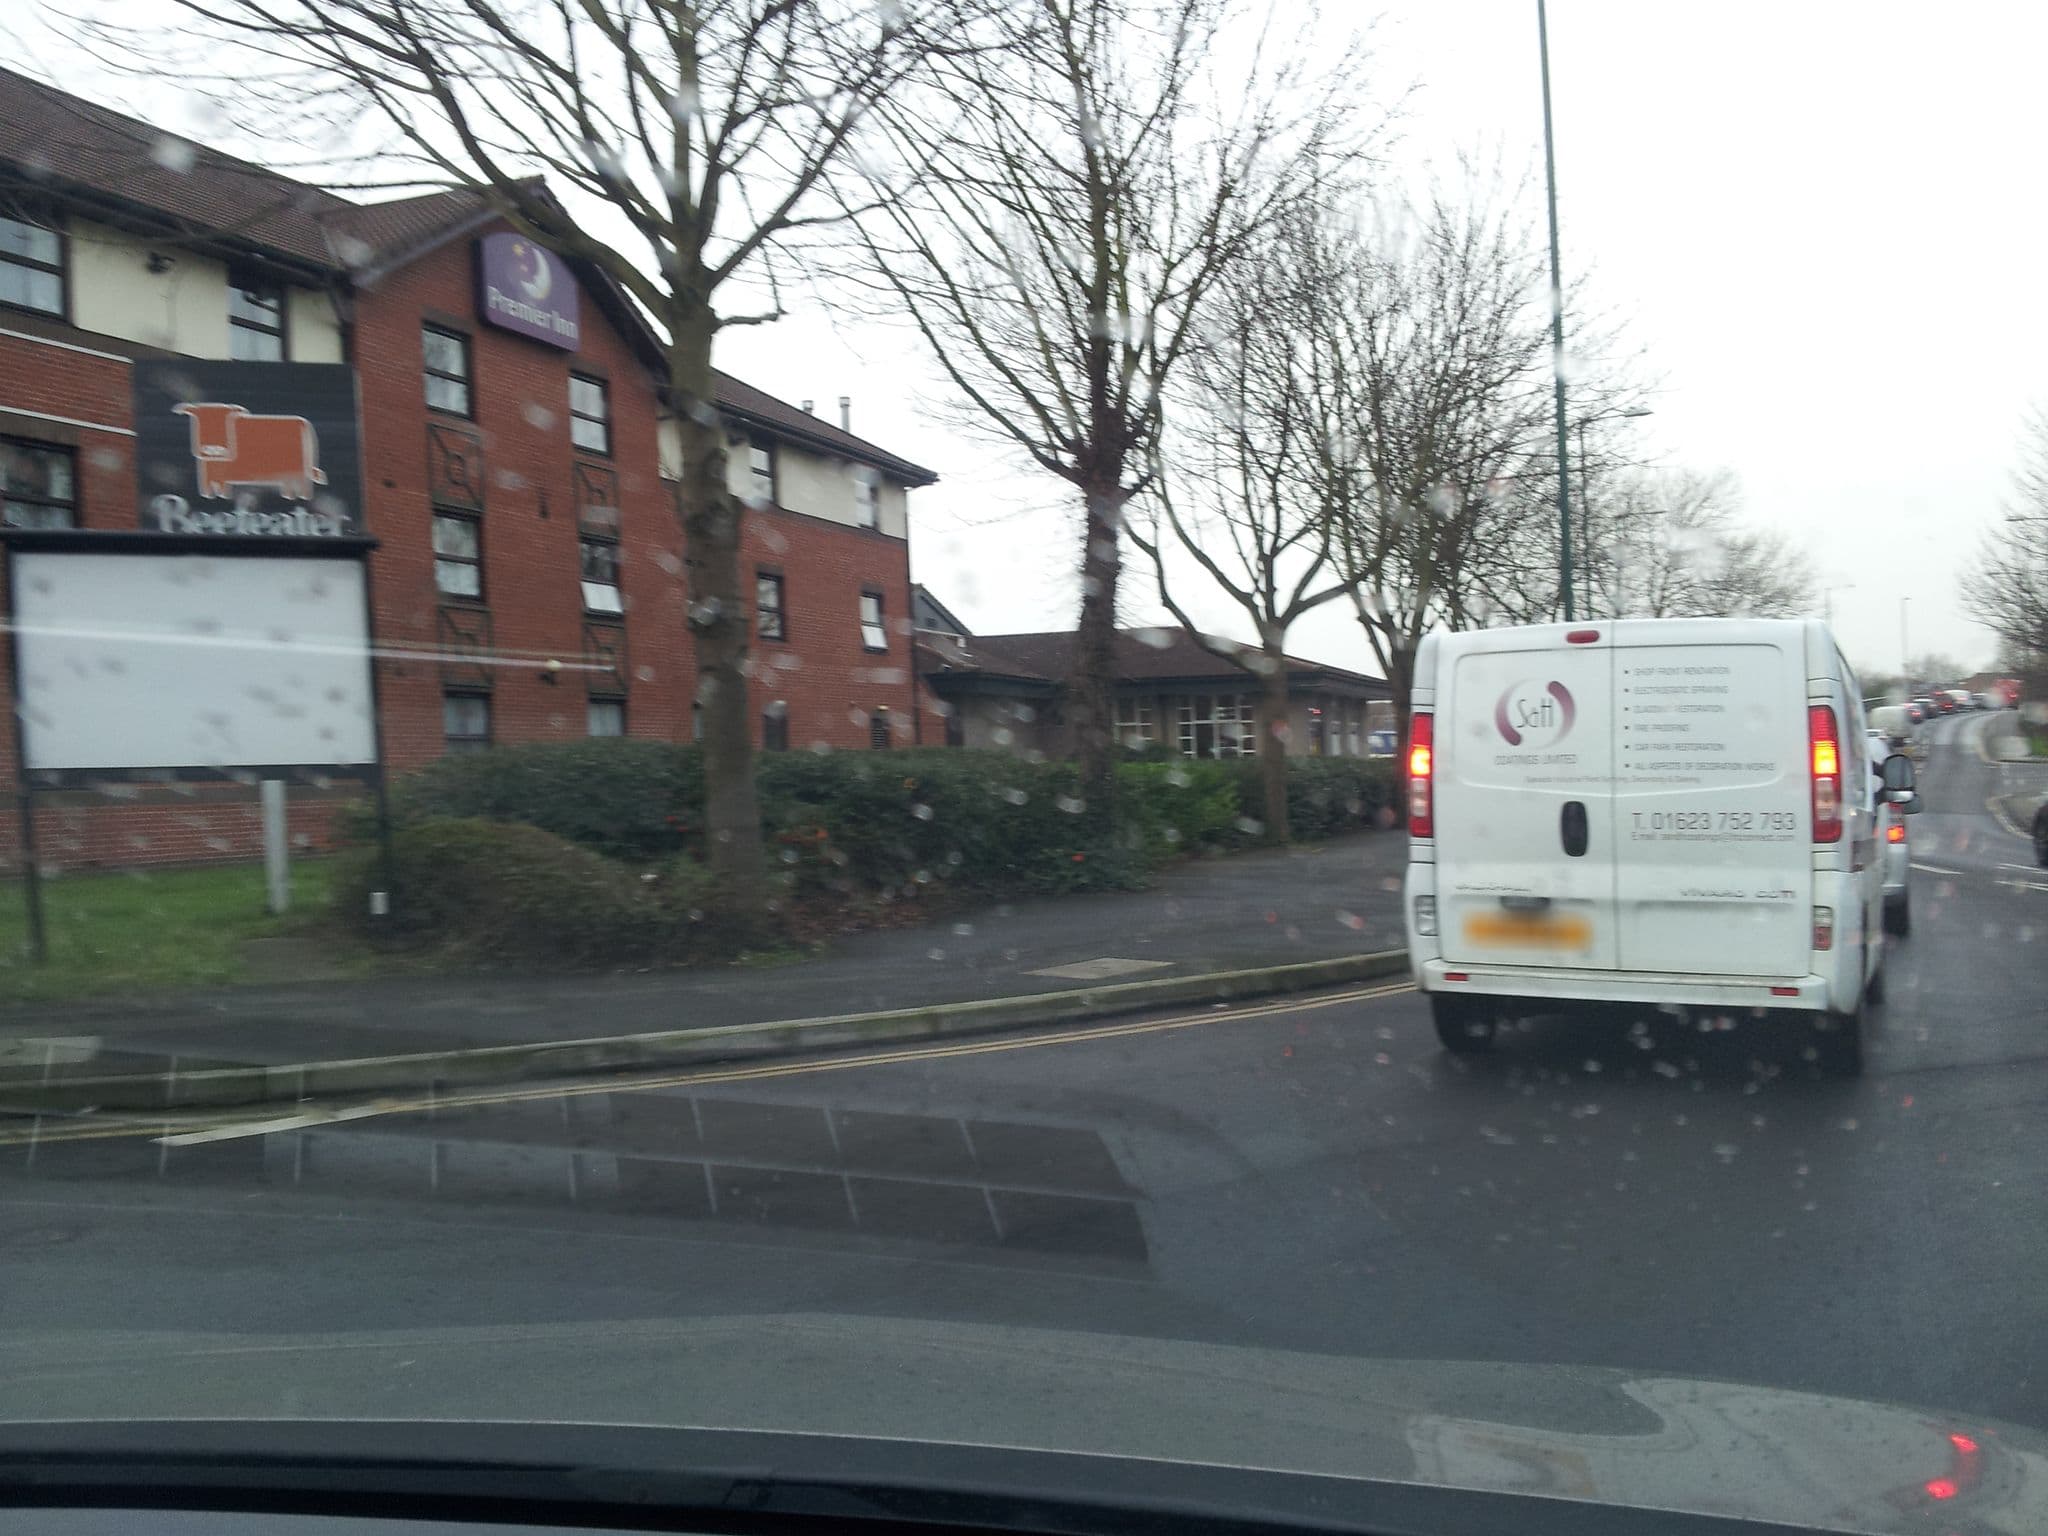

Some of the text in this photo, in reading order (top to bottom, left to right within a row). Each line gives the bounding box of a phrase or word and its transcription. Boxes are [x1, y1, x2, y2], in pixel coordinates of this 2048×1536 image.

[487, 286, 578, 339] Premier Inn
[1651, 812, 1711, 830] 01623
[1716, 812, 1753, 830] 752
[1759, 812, 1797, 831] 793
